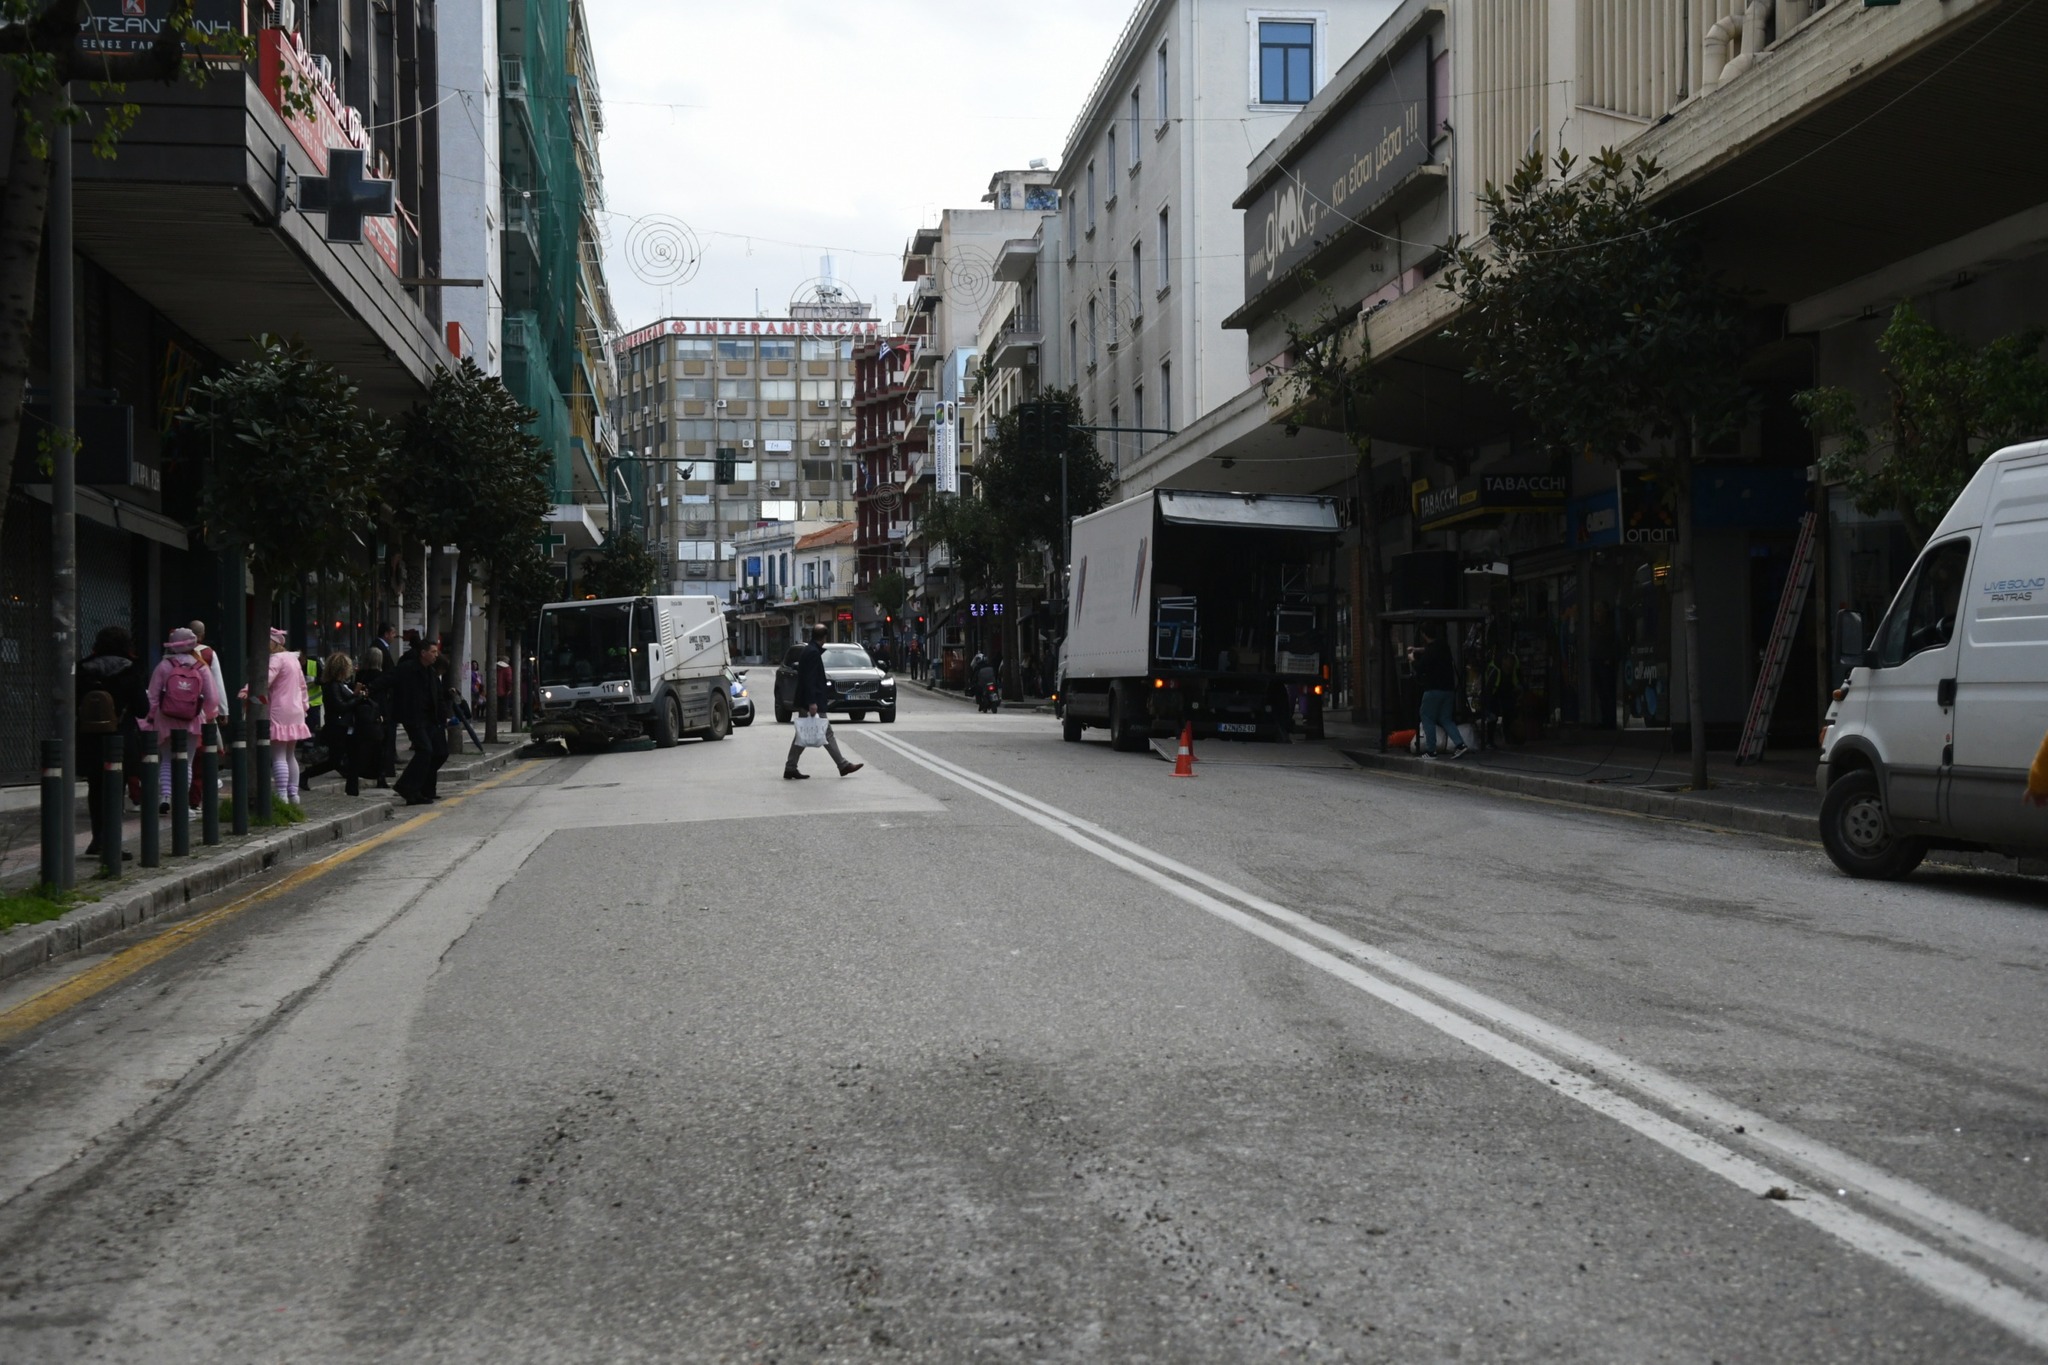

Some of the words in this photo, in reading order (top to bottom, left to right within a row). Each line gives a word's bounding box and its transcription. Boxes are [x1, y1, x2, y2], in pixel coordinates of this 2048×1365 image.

[82, 39, 121, 49] ΞΕΝΕΣ
[1332, 174, 1346, 209] και
[1375, 126, 1402, 182] μέσα
[1405, 102, 1418, 146] !!!
[696, 320, 878, 335] INTERAMERICAN
[1485, 476, 1566, 491] TABACCHI
[1420, 483, 1459, 519] TABACCHI
[1984, 581, 2006, 591] LIVE
[2007, 577, 2046, 589] SOUND
[1991, 591, 2032, 602] PATRAS
[602, 684, 615, 694] 117
